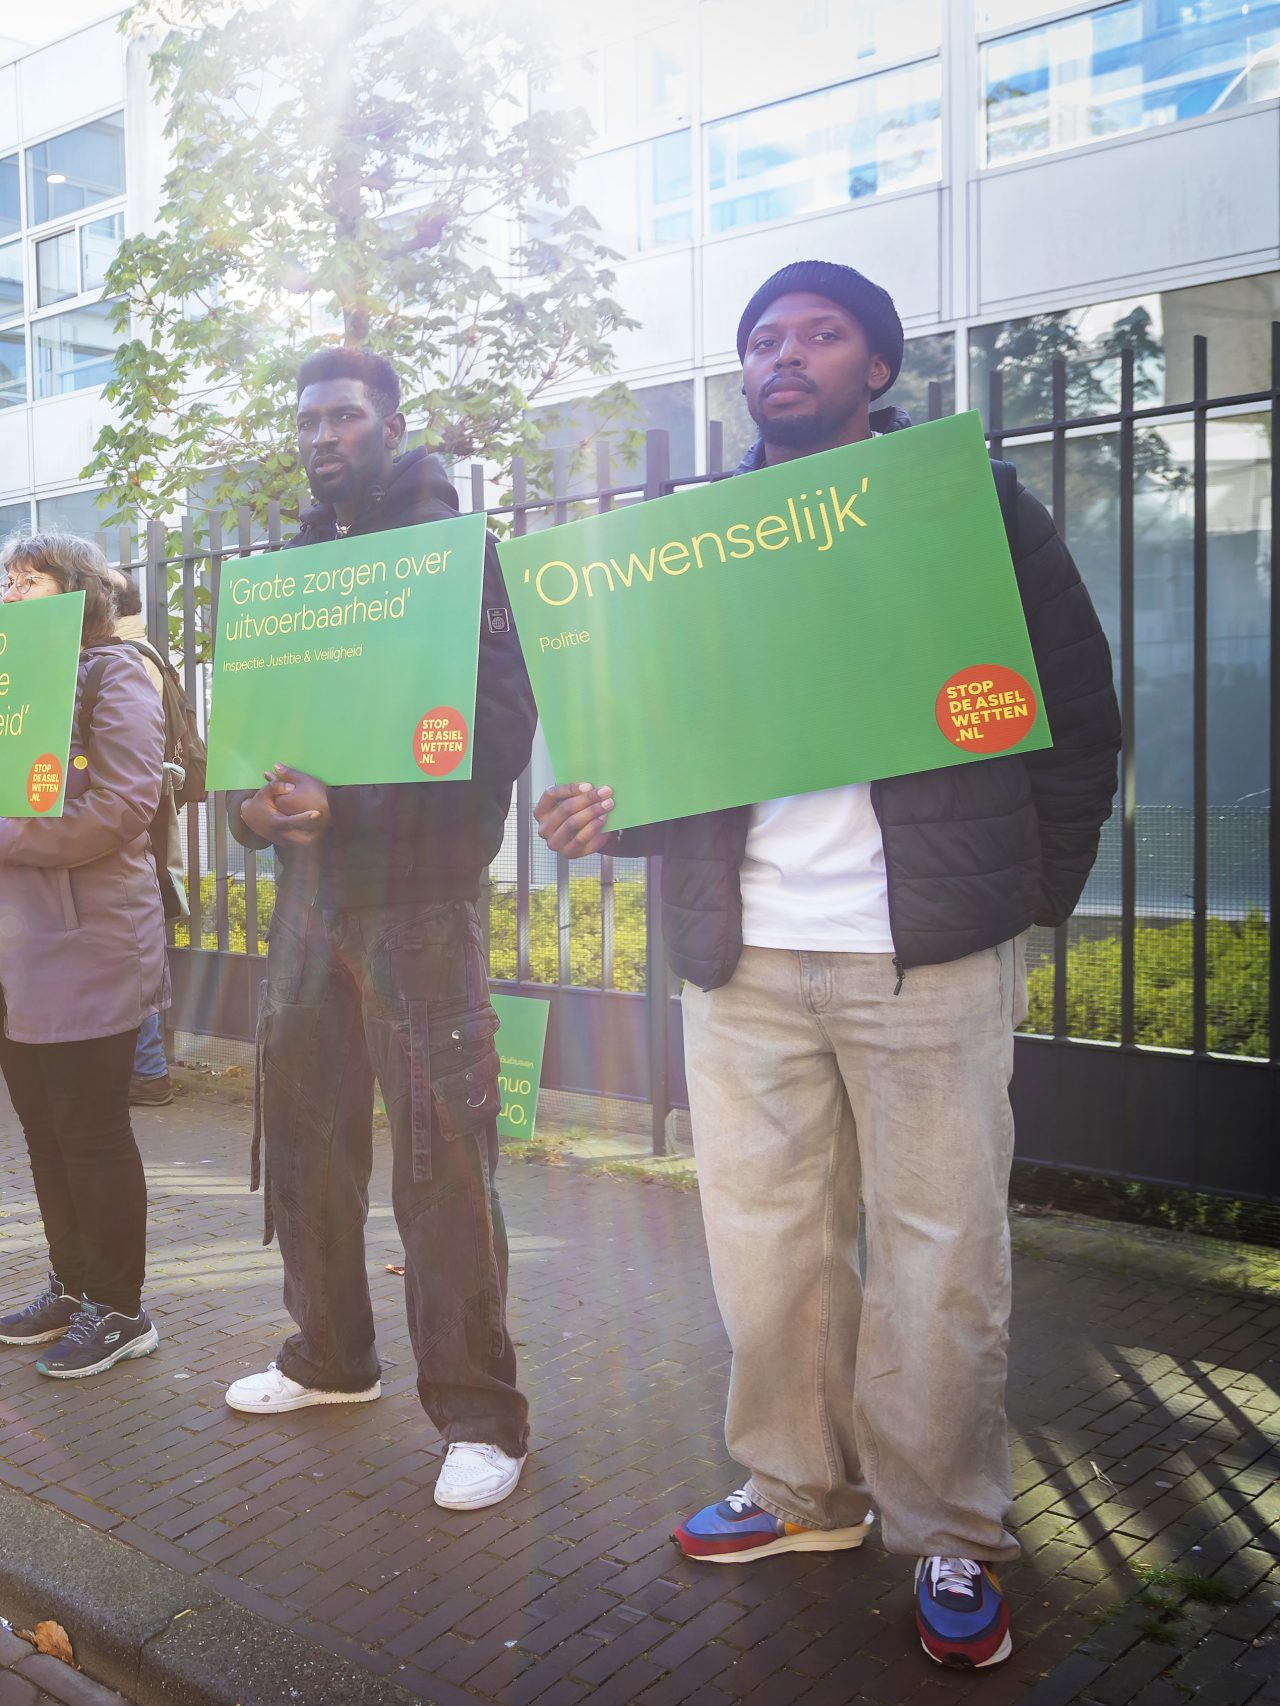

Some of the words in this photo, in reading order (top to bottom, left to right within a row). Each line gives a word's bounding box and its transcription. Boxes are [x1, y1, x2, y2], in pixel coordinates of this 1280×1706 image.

[523, 477, 869, 606] 'Onwenselijk'
[228, 573, 296, 605] 'Grote
[302, 561, 386, 596] zorgen
[395, 549, 452, 579] over
[225, 587, 411, 641] uitvoerbaarheid'
[539, 627, 590, 653] Politie
[222, 658, 265, 673] Inspectie
[266, 653, 301, 667] Justitie
[303, 651, 311, 662] &
[314, 644, 363, 662] Veiligheid
[946, 680, 994, 699] STOP
[949, 698, 973, 713] DE
[975, 690, 1026, 709] ASIEL
[422, 718, 449, 729] STOP
[951, 703, 1028, 728] WETTEN
[421, 730, 435, 741] DE
[435, 730, 463, 741] ASIEL
[955, 726, 985, 742] .NL
[420, 741, 463, 752] WETTEN
[419, 753, 436, 764] .NL
[34, 763, 52, 773] STOP
[32, 773, 42, 783] DE
[41, 773, 59, 783] ASIEL
[31, 783, 59, 793] WETTEN
[29, 793, 41, 802] .NL
